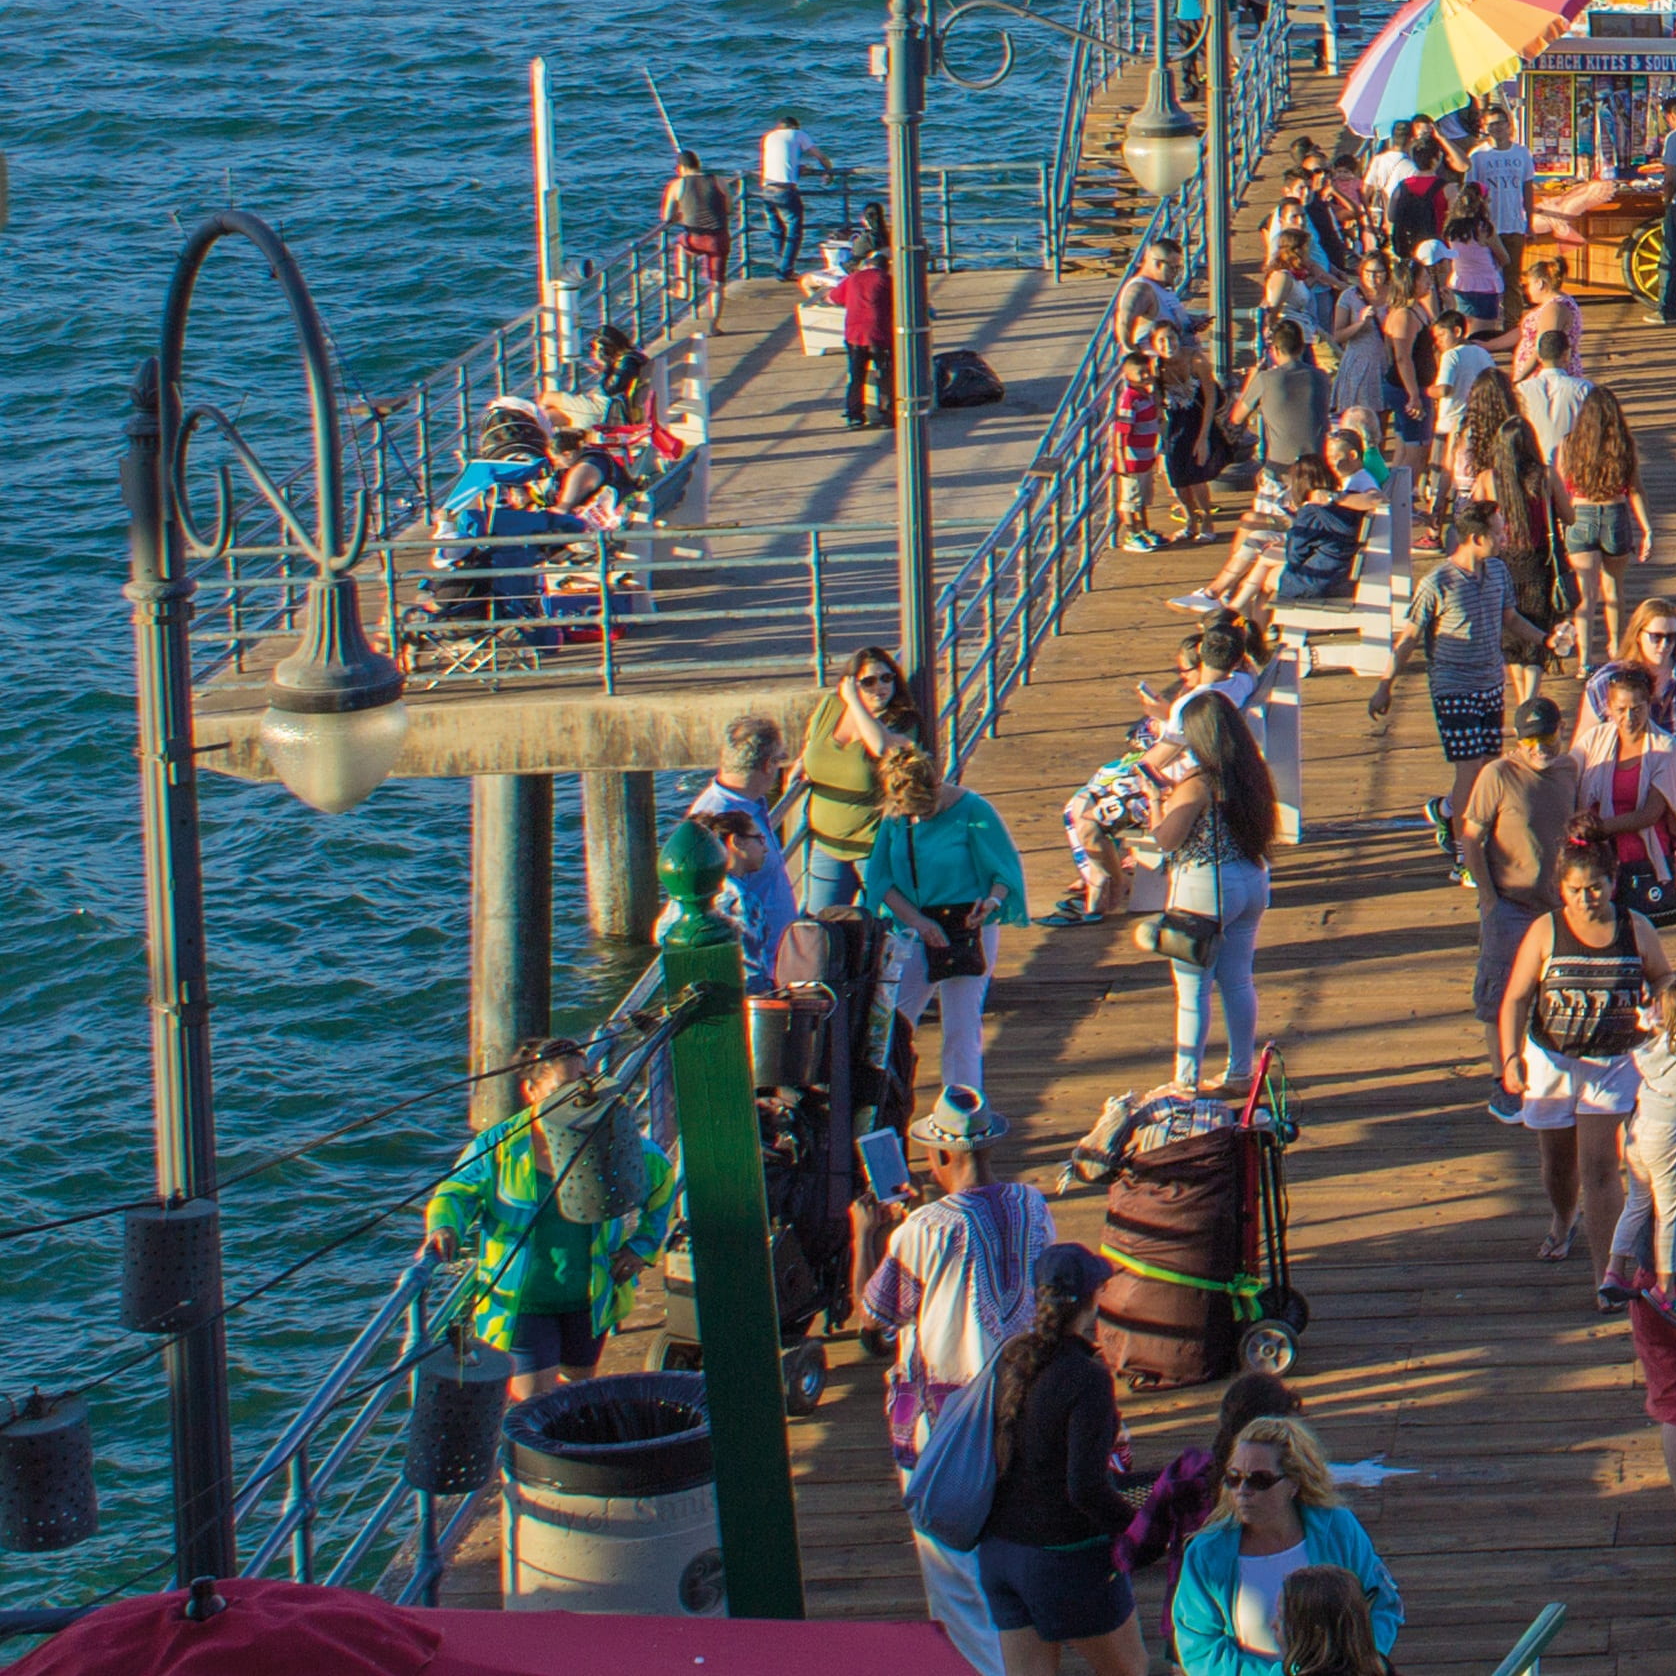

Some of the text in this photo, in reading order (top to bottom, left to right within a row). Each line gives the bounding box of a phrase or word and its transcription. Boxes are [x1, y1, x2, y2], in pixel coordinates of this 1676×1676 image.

[1539, 56, 1581, 70] BEACH
[1586, 56, 1627, 71] KITES
[1630, 56, 1641, 70] &
[1487, 157, 1522, 169] AERO
[1486, 176, 1520, 189] NYC
